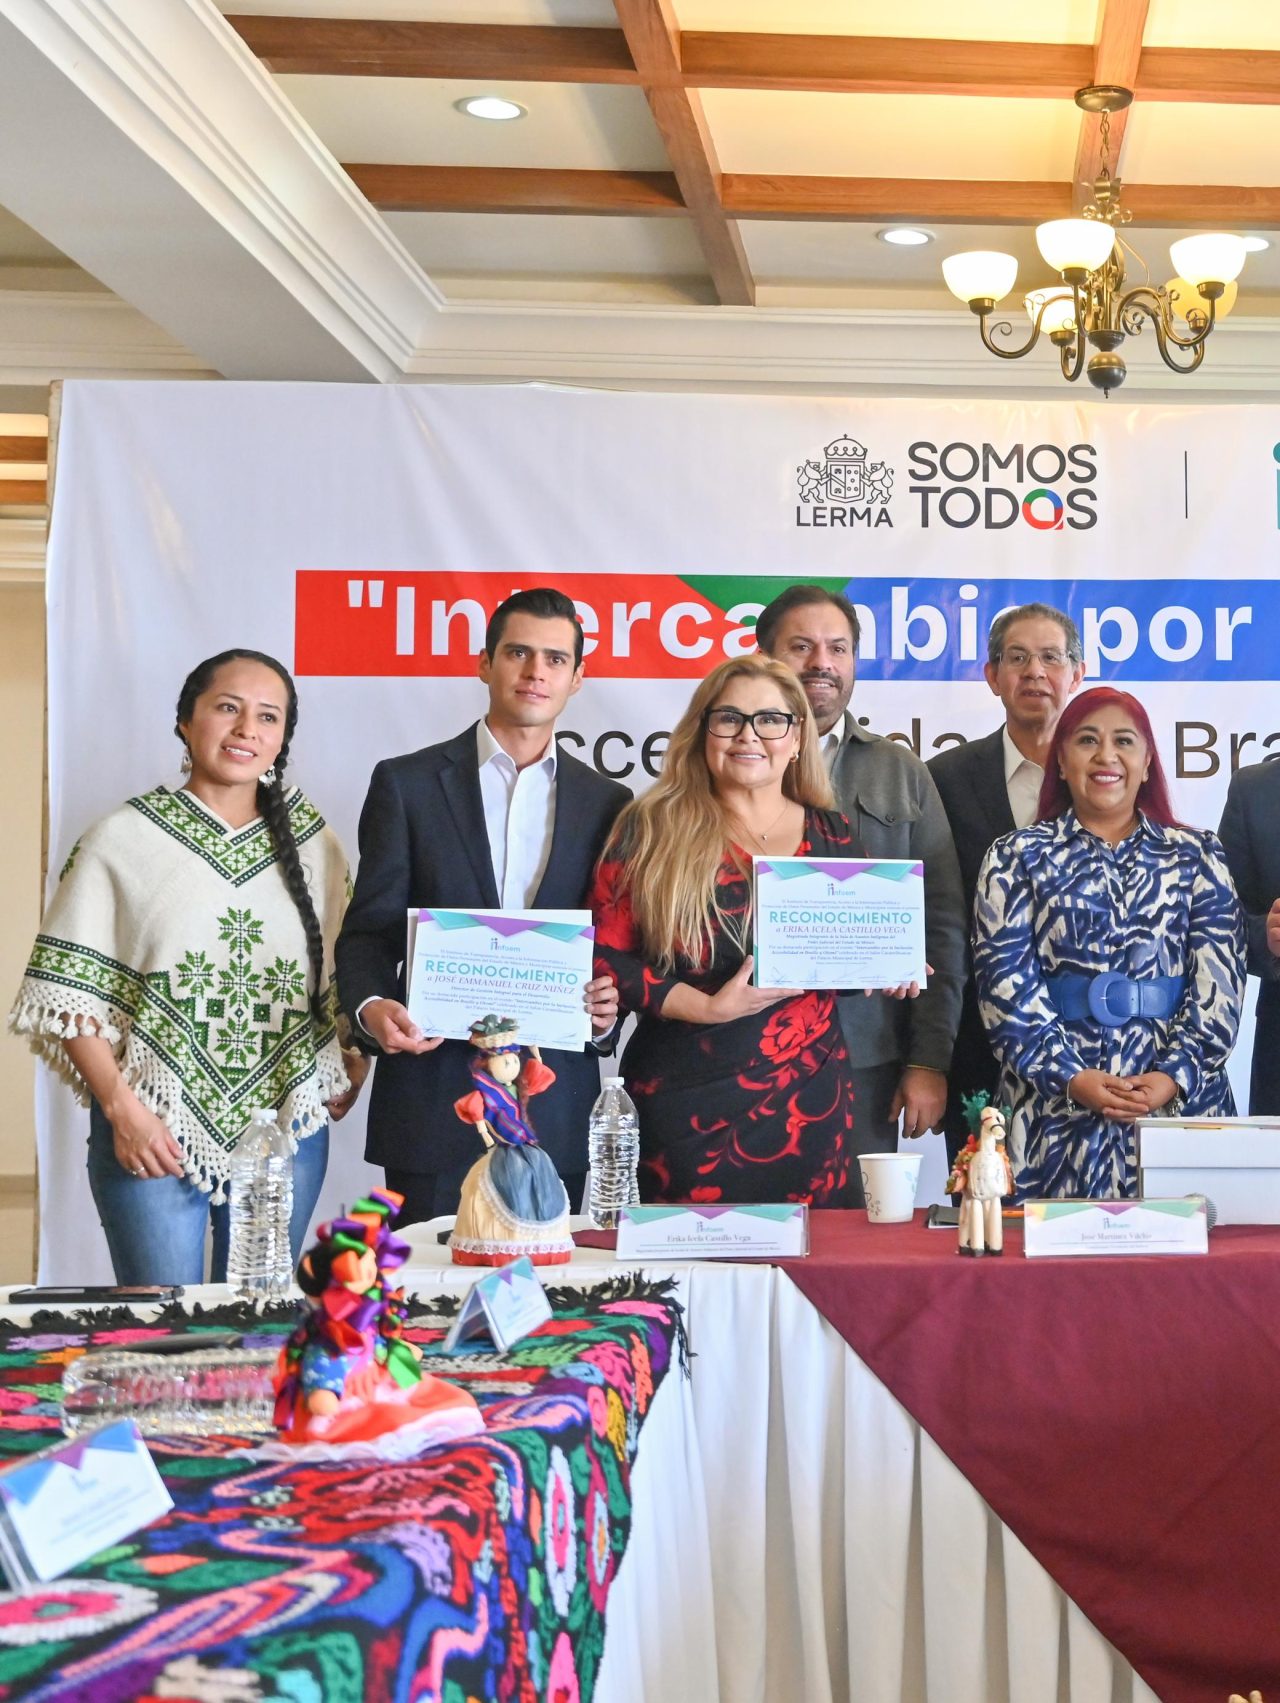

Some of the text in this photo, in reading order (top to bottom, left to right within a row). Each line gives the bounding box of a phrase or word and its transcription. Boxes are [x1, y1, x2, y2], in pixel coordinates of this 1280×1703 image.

[908, 441, 1098, 484] SOMOS
[796, 506, 894, 528] LERMA
[347, 580, 1019, 662] "Inrcabi
[1084, 604, 1253, 678] por
[769, 911, 912, 925] RECONOCIMIENTO
[783, 925, 810, 933] ERIKA
[839, 926, 882, 934] CASTILLO
[883, 926, 907, 934] VEGA
[425, 960, 578, 985] RECONOCIMIENTO
[458, 976, 512, 988] EMMANUEL
[515, 982, 543, 991] CRUZ
